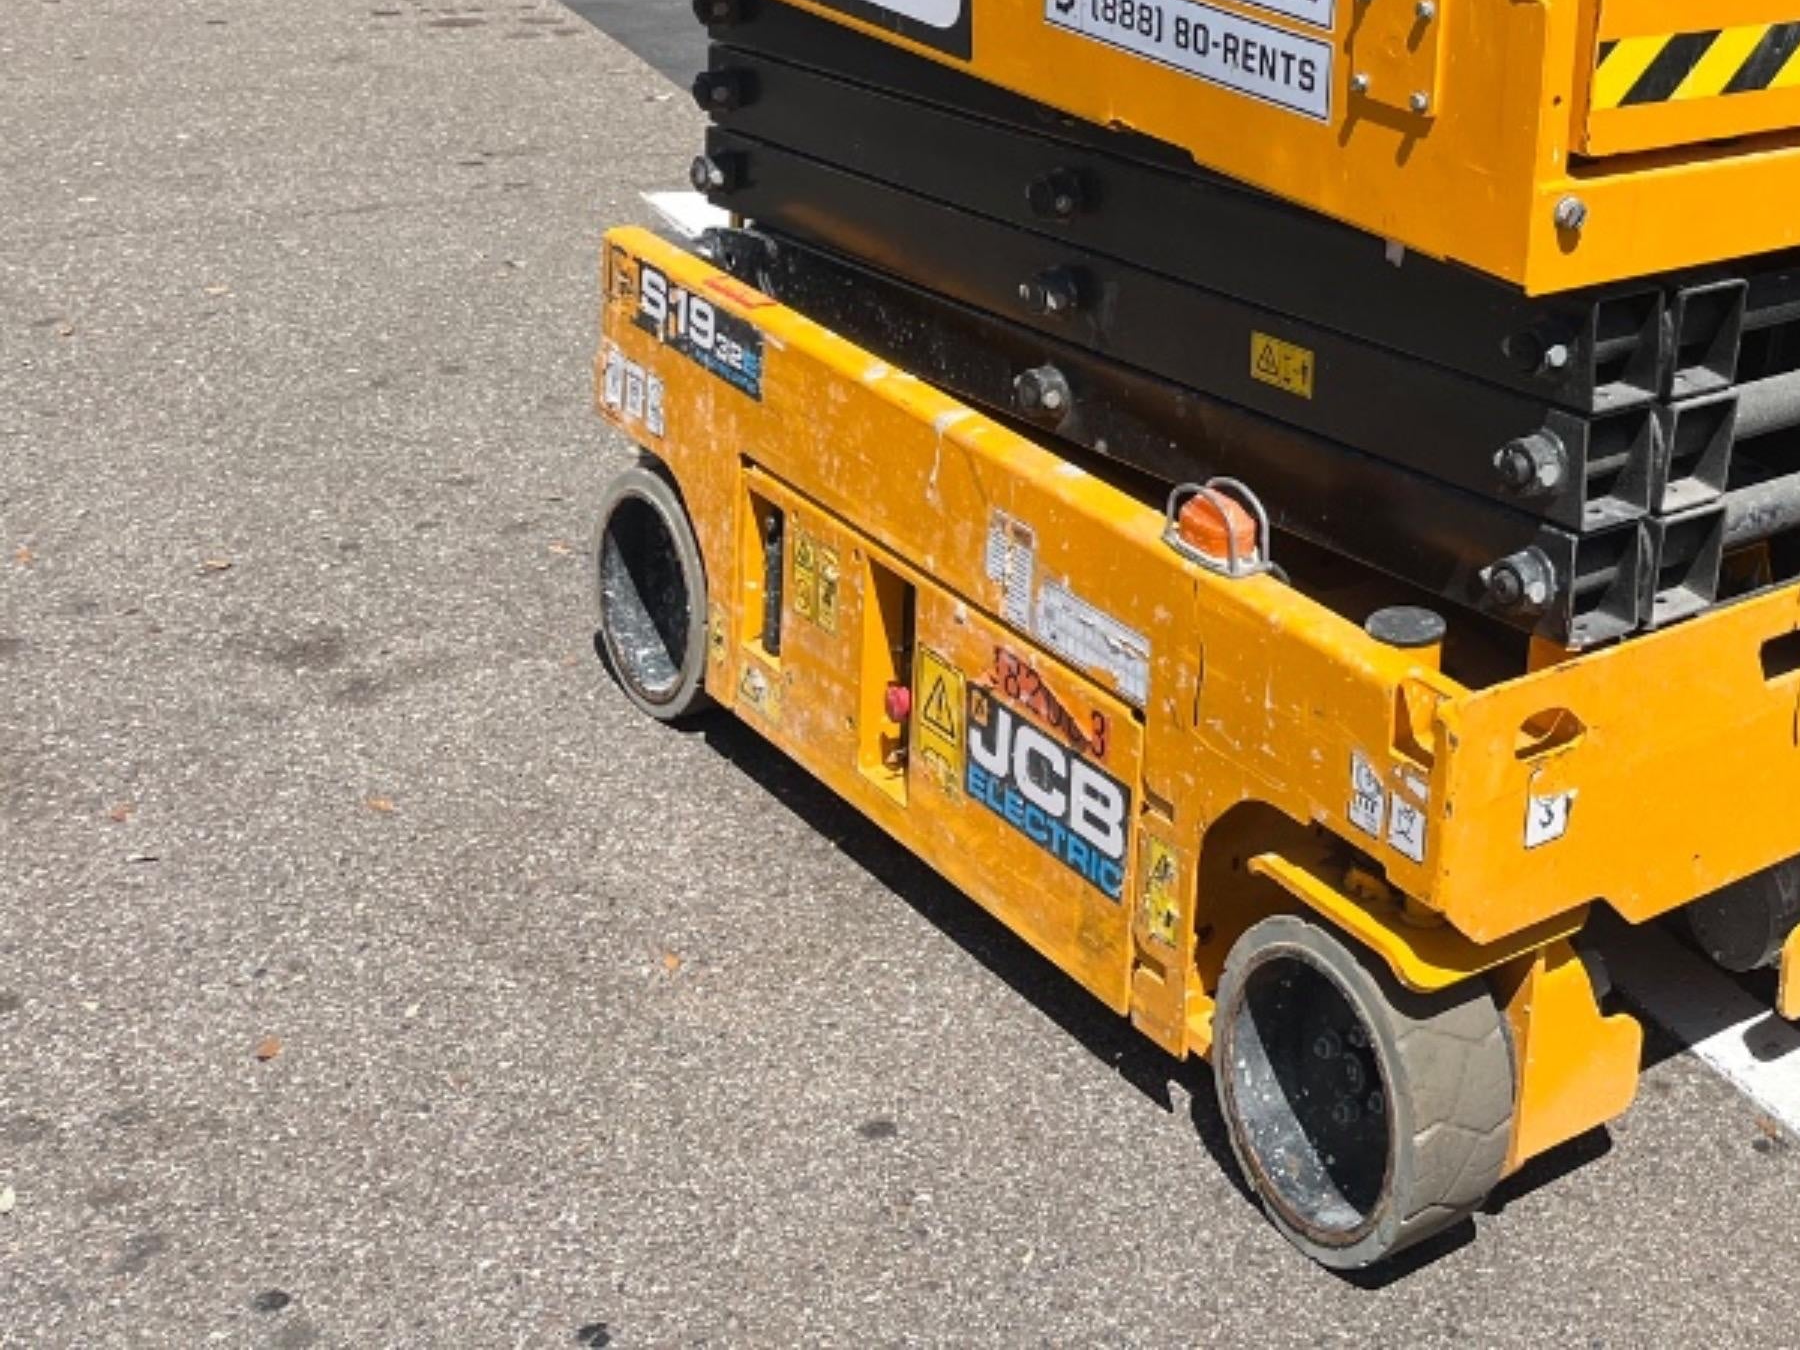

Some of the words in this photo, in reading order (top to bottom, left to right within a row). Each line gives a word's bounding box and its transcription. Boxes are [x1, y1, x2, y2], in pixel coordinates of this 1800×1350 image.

[1174, 14, 1316, 93] 80-RENTS
[967, 762, 1123, 899] ELECTRIC
[968, 706, 1125, 860] JCB
